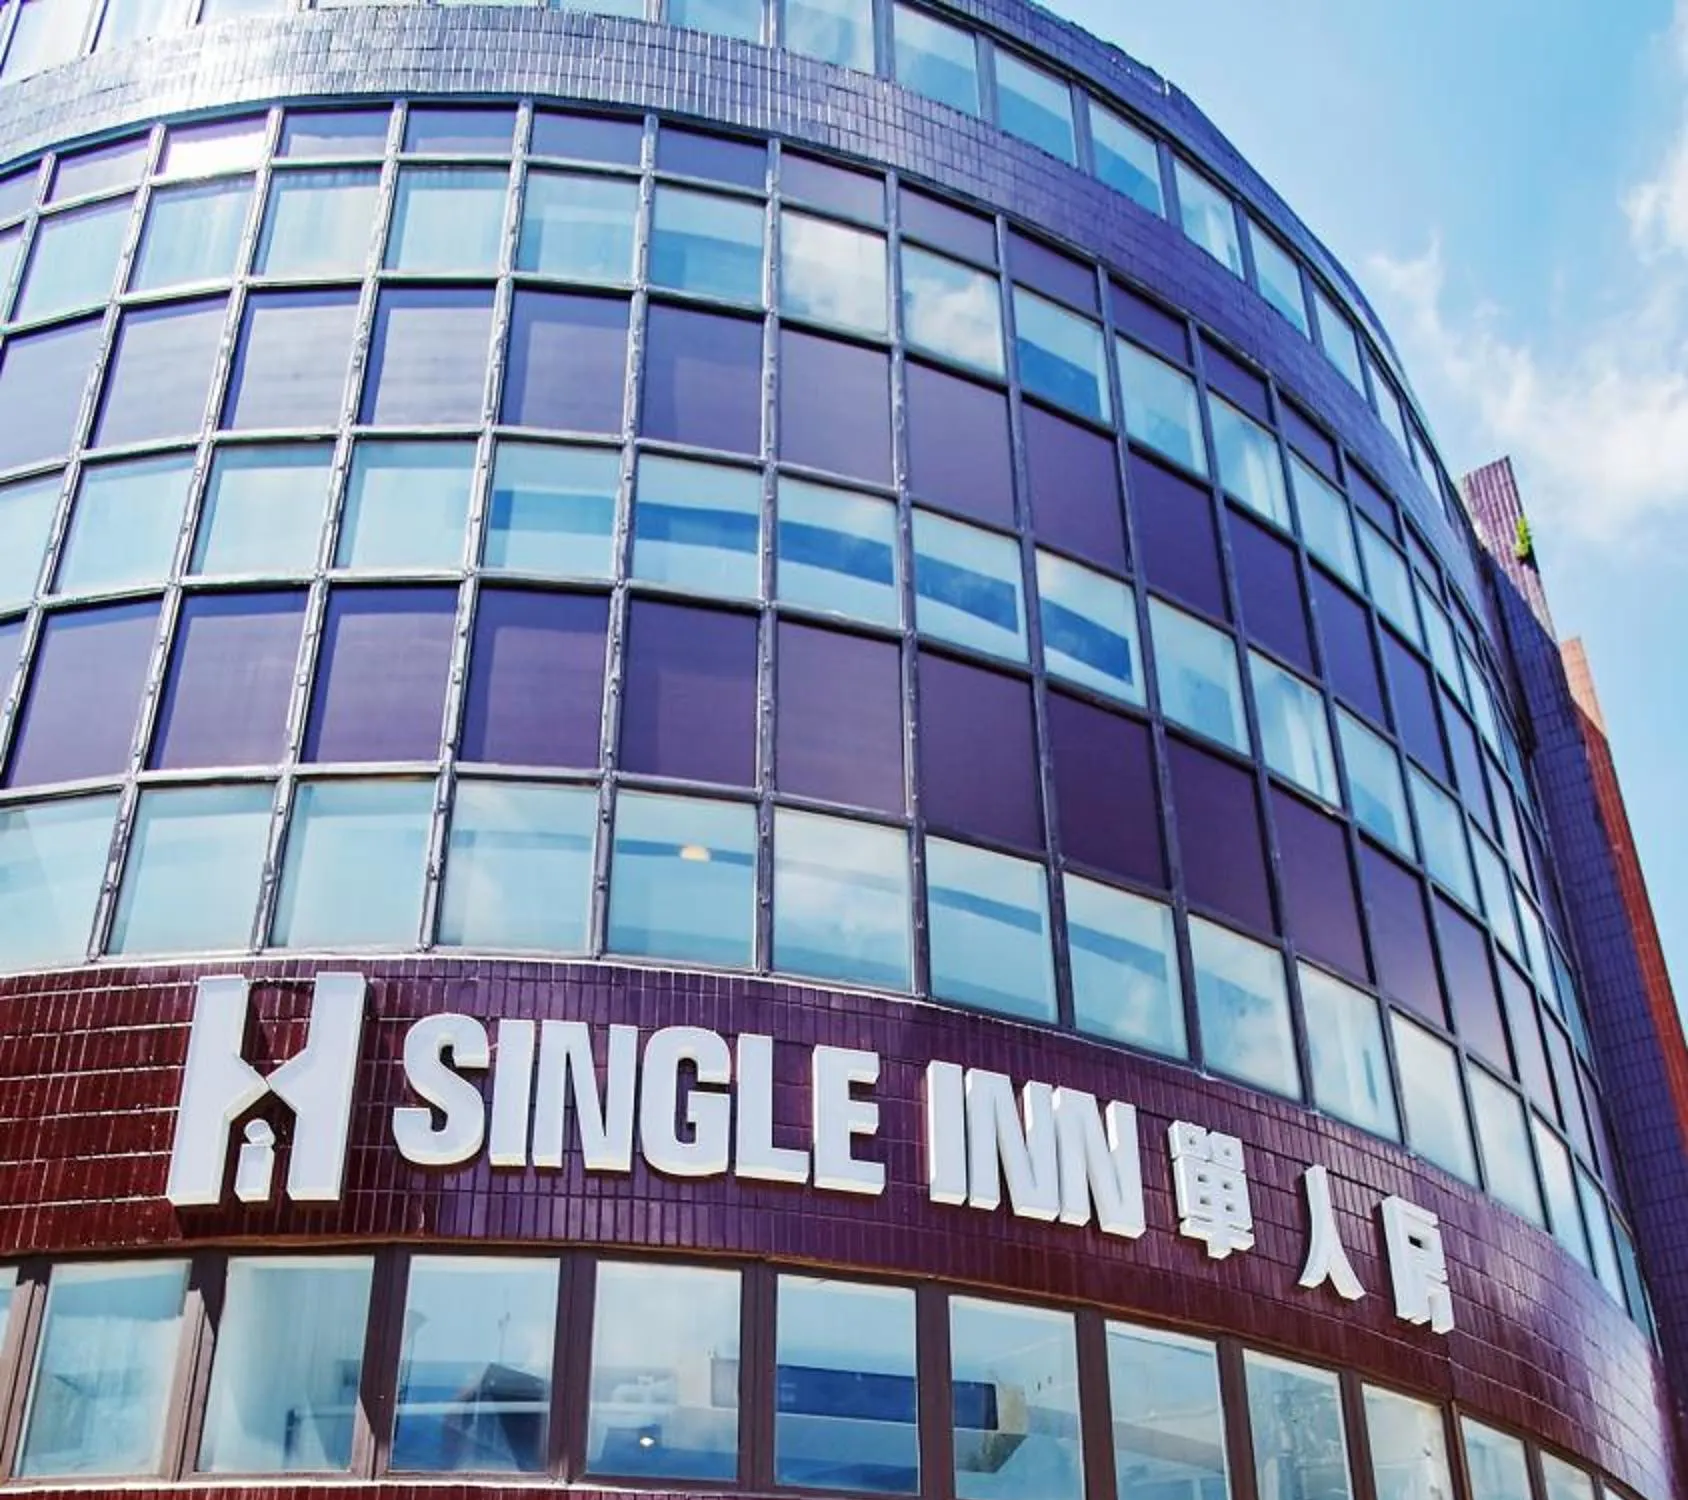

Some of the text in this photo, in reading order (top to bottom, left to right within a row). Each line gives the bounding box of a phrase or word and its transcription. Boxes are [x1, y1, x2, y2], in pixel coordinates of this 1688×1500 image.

[392, 1013, 1147, 1239] SINGLE INN
[1168, 1119, 1455, 1336] 單人房
